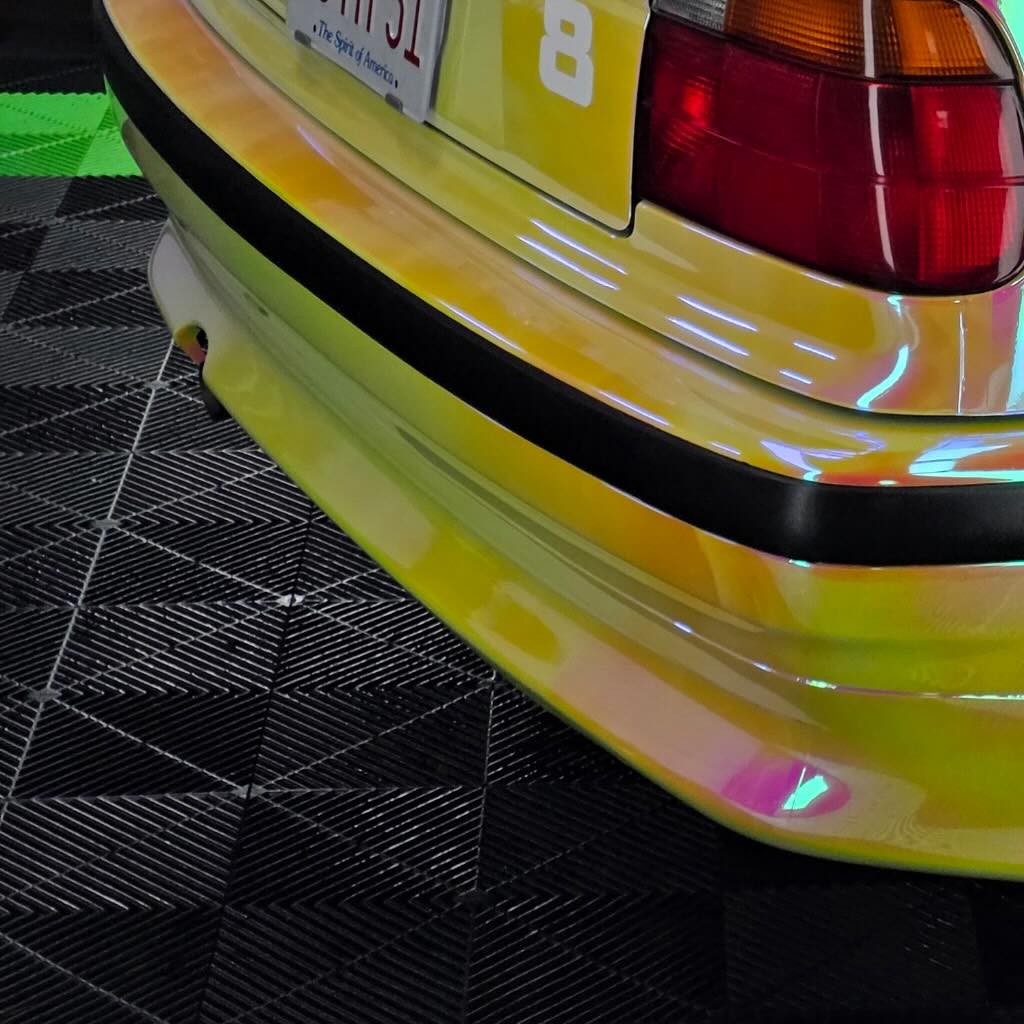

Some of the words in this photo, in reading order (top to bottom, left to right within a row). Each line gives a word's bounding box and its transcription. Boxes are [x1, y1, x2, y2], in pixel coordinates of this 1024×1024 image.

[318, 19, 334, 43] The
[335, 30, 355, 57] Spirit
[354, 47, 365, 66] of
[363, 51, 394, 85] America
